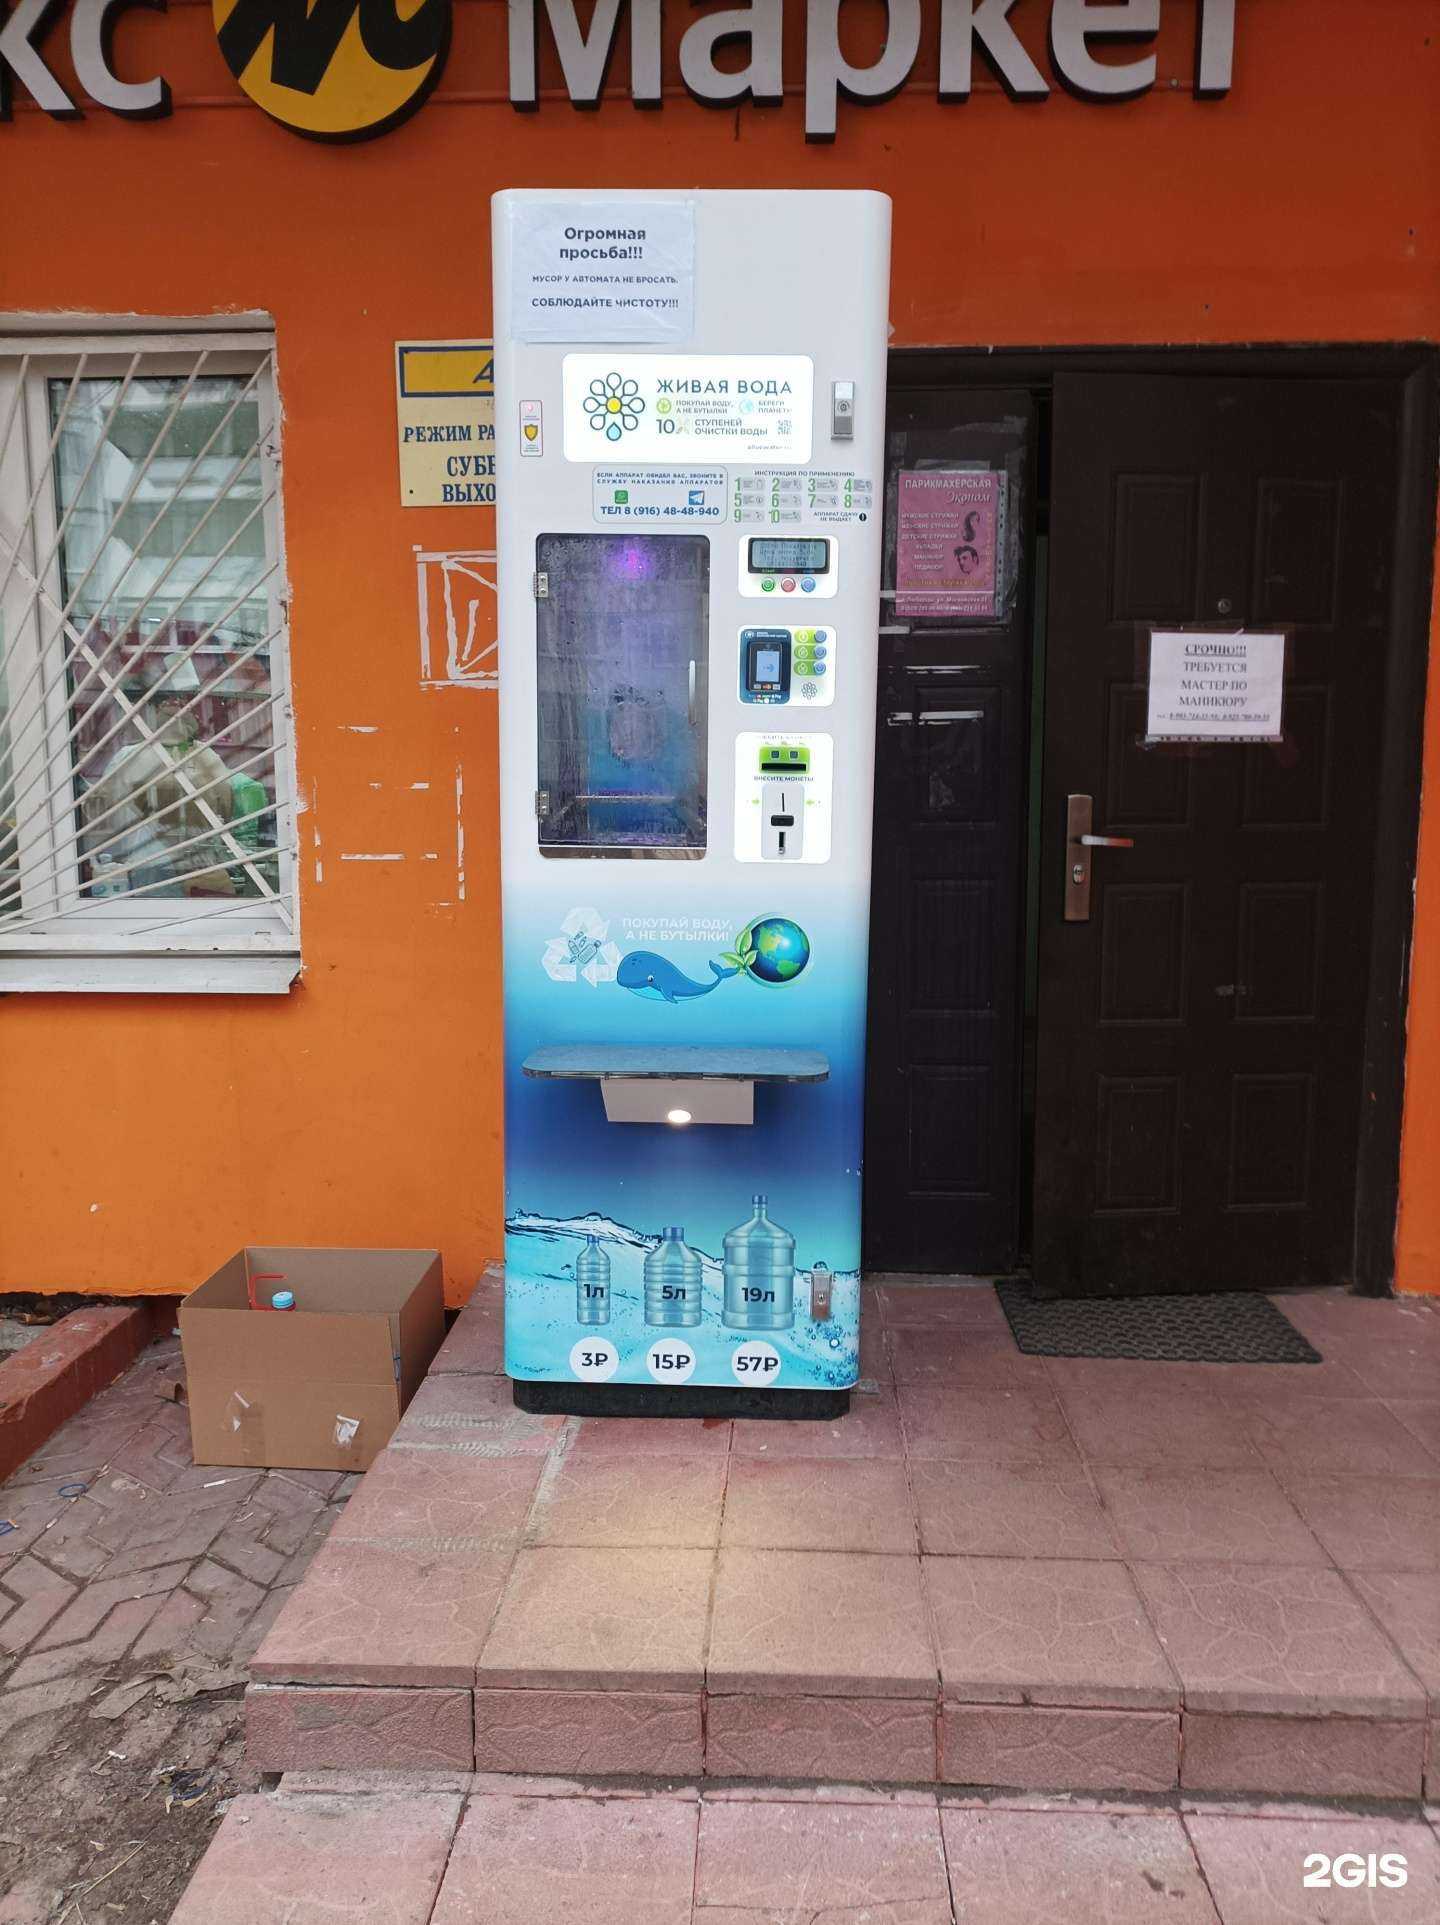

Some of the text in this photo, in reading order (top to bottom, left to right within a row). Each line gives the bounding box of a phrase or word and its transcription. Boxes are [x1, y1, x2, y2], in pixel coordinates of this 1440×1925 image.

[564, 227, 646, 242] Огромная
[559, 246, 643, 261] просьба!!!
[532, 275, 679, 284] МУСОР У АВТОМАТА НЕ БРОСАТЬ.
[532, 297, 679, 309] СОБЛЮДАЙТЕ ЧИСТОТУ!!!
[657, 379, 792, 396] ЖИВАЯ ВОДА
[676, 399, 711, 407] ПОКУПАЙ
[656, 418, 743, 434] 10 СТУПЕНЕЙ
[694, 428, 768, 436] ОЧИСТКИ ВОДЫ
[403, 425, 472, 443] РЕЖИМ
[735, 478, 741, 491] 1
[772, 478, 780, 492] 2
[808, 478, 816, 492] 3
[844, 478, 852, 492] 4
[905, 479, 992, 489] ПАРИКМАХЕРСКАЯ
[734, 493, 742, 507] 5
[772, 493, 779, 508] 6
[808, 494, 816, 508] 7
[844, 494, 852, 508] 8
[600, 506, 720, 516] ТЕЛ 8 (916) 48-48-940
[734, 509, 741, 523] 9
[769, 509, 780, 523] 10
[1185, 644, 1247, 655] СРОЧНО!!!
[1184, 661, 1247, 673] ТРЕБУЕТСЯ
[1181, 680, 1248, 690] МАСТЕР ПО
[1179, 696, 1248, 707] МАНИКЮРУ
[623, 916, 733, 932] ПОКУПАЙ ВОДУ,
[626, 930, 729, 942] А НЕ БУТЫЛКИ!
[583, 1284, 775, 1303] 1л 5л 19л
